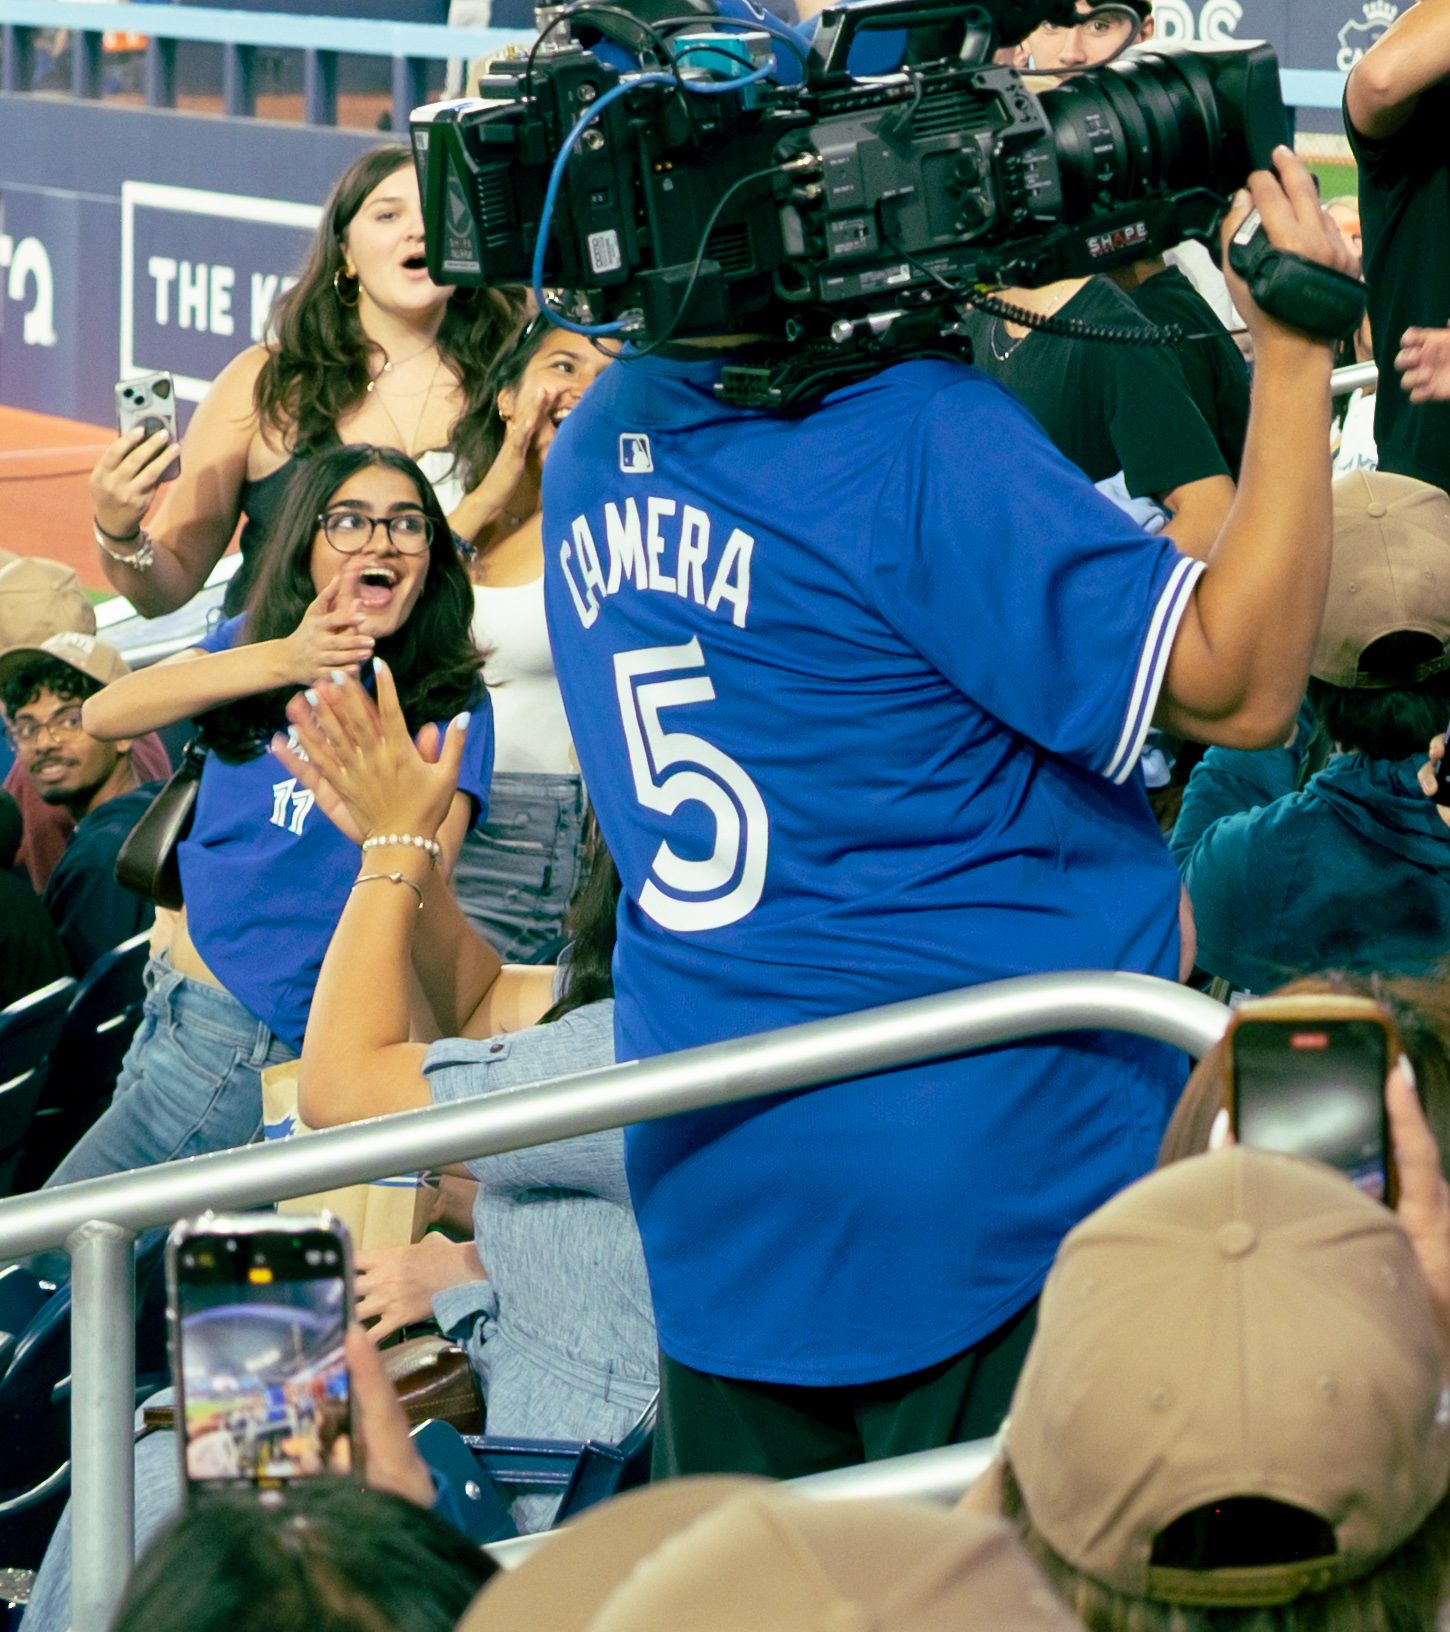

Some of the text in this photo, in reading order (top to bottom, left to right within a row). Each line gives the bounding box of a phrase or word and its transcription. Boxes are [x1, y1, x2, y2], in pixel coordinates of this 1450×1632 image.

[1085, 220, 1149, 250] SHAPE
[148, 255, 236, 337] THE
[558, 495, 756, 631] CAMERA
[612, 634, 770, 933] 5
